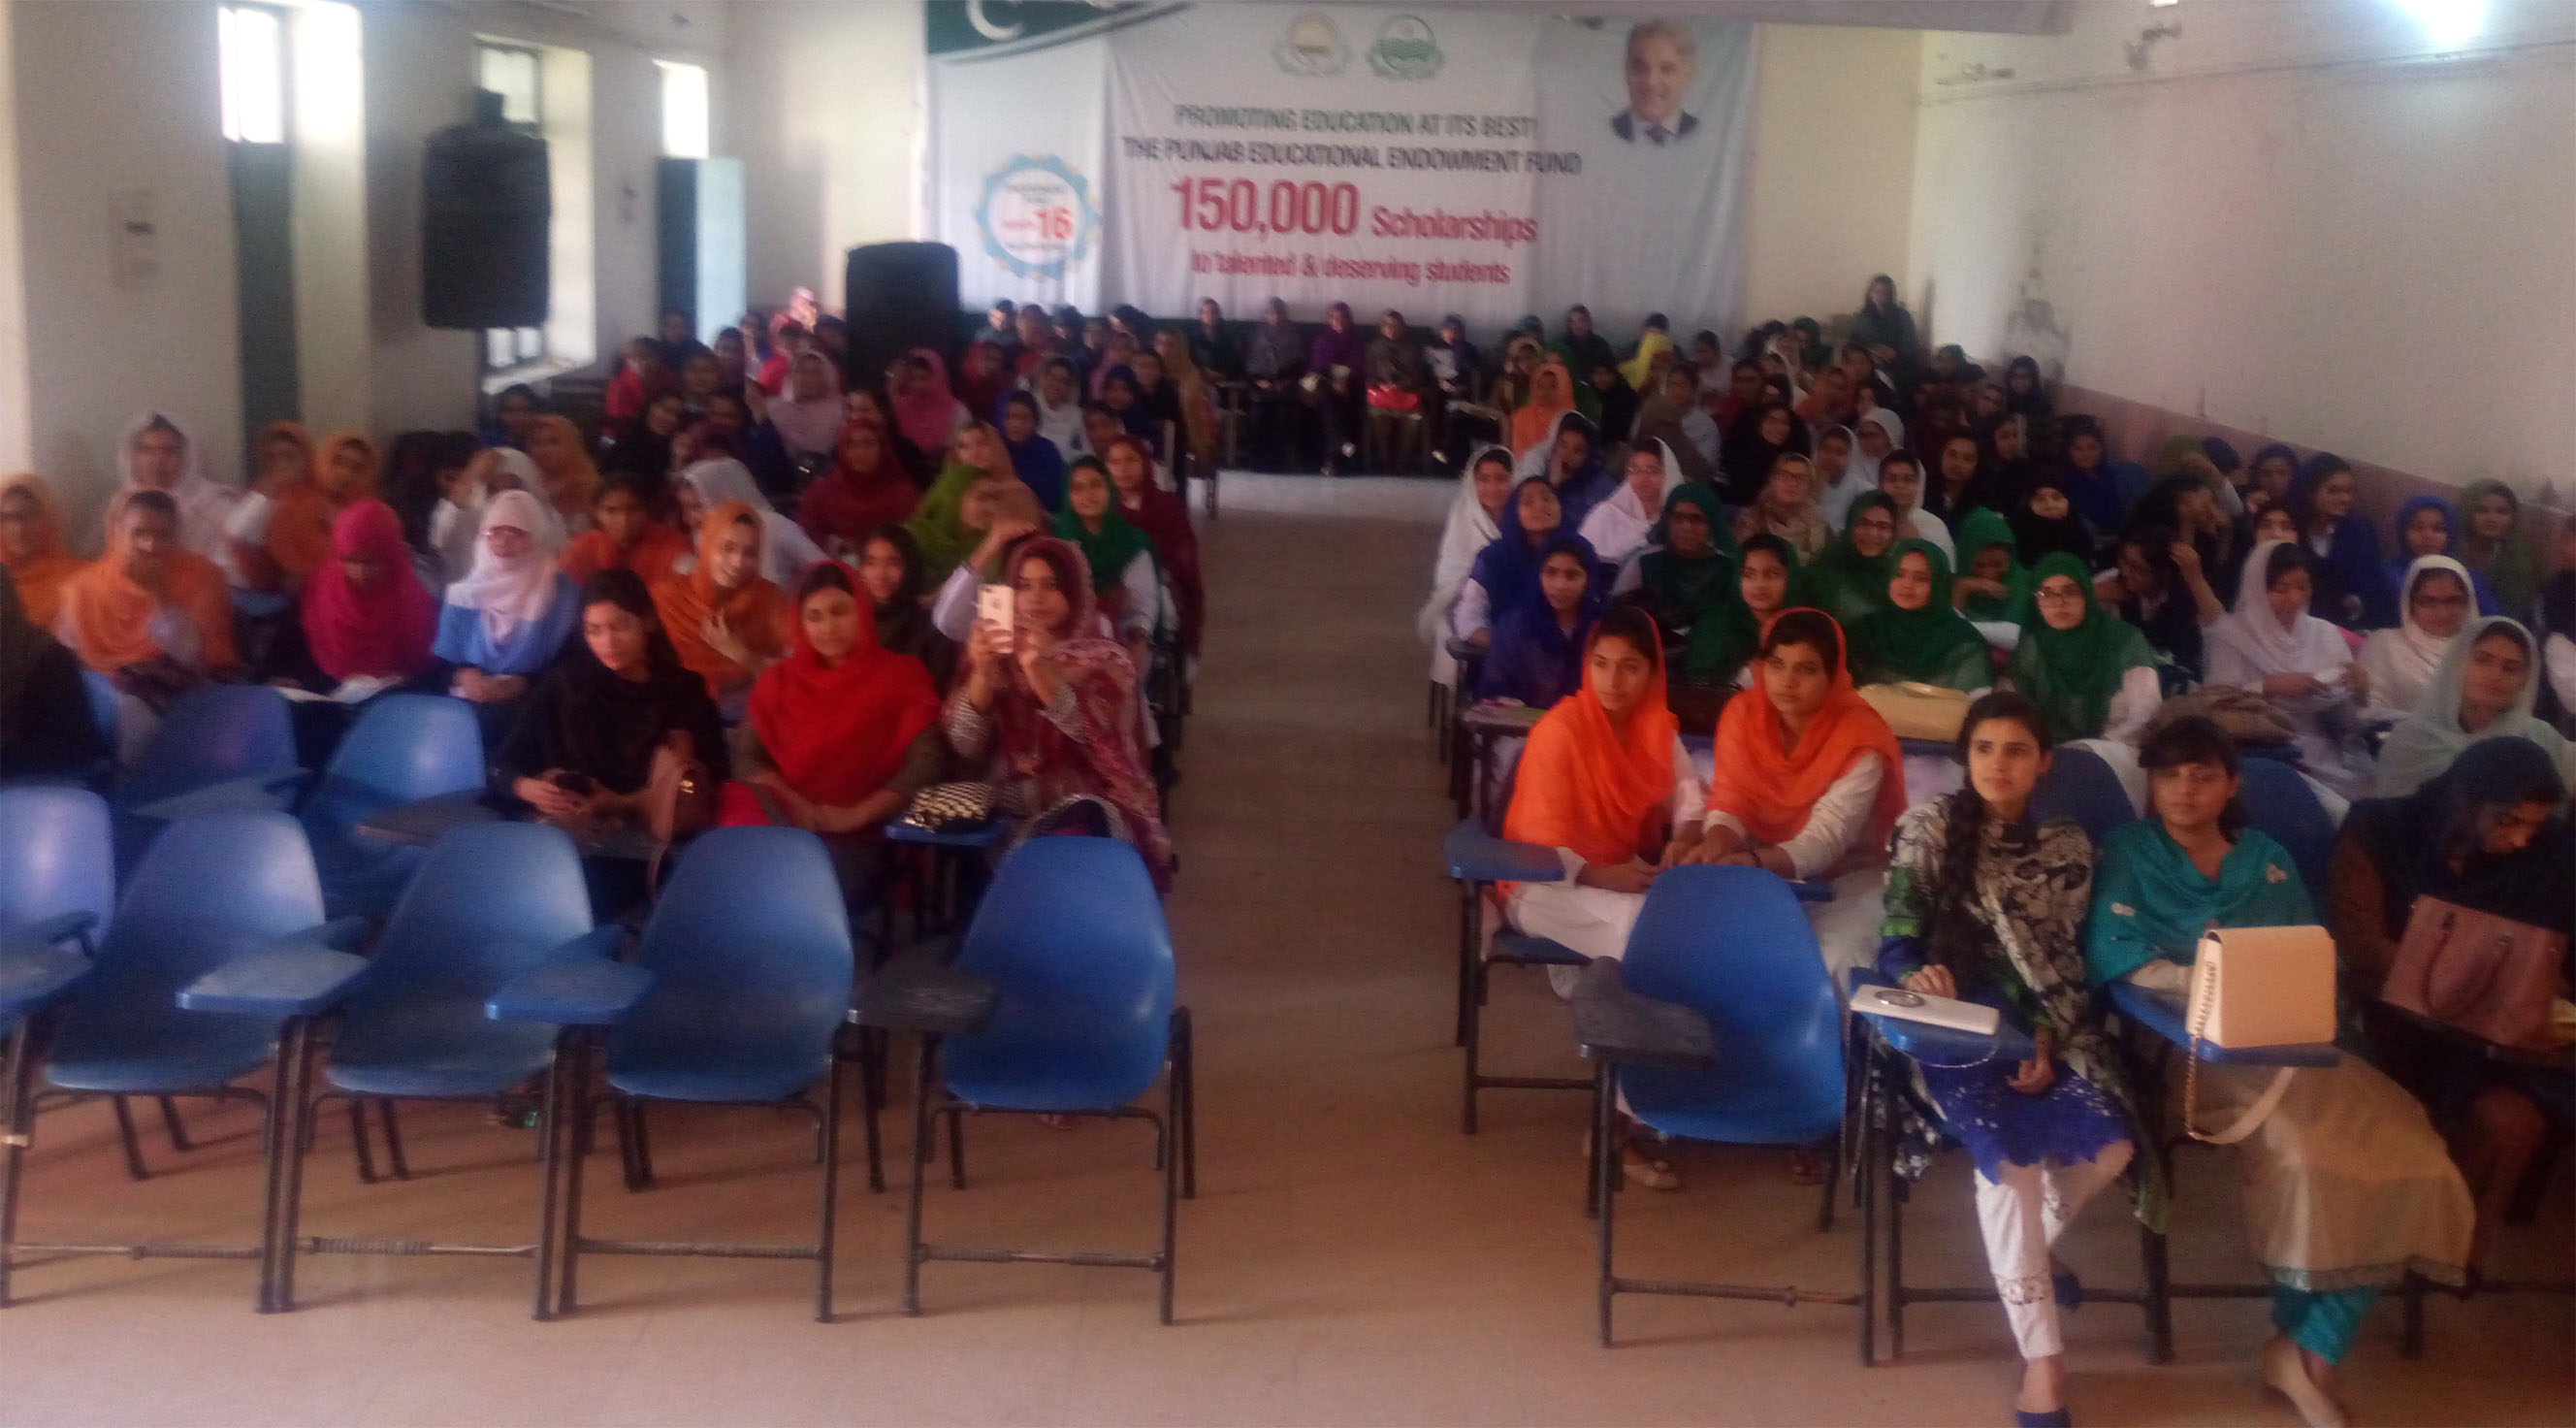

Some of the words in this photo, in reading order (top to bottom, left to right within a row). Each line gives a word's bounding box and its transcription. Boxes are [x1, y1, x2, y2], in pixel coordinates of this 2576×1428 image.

[1301, 109, 1413, 135] EDUCATION
[1416, 113, 1441, 137] AT
[1122, 136, 1163, 161] THE
[1164, 137, 1244, 164] PUNJAB
[1246, 141, 1385, 169] EDUCATIONAL
[1387, 146, 1524, 173] ENDOWMENT
[1525, 149, 1583, 174] FUND
[1037, 207, 1075, 241] 16
[1172, 176, 1360, 242] 150,000
[1372, 206, 1538, 249] Scholarships
[1191, 248, 1211, 275] to
[1213, 249, 1298, 276] talented
[1302, 251, 1319, 278] &
[1321, 254, 1421, 288] deserving
[1424, 257, 1512, 285] students
